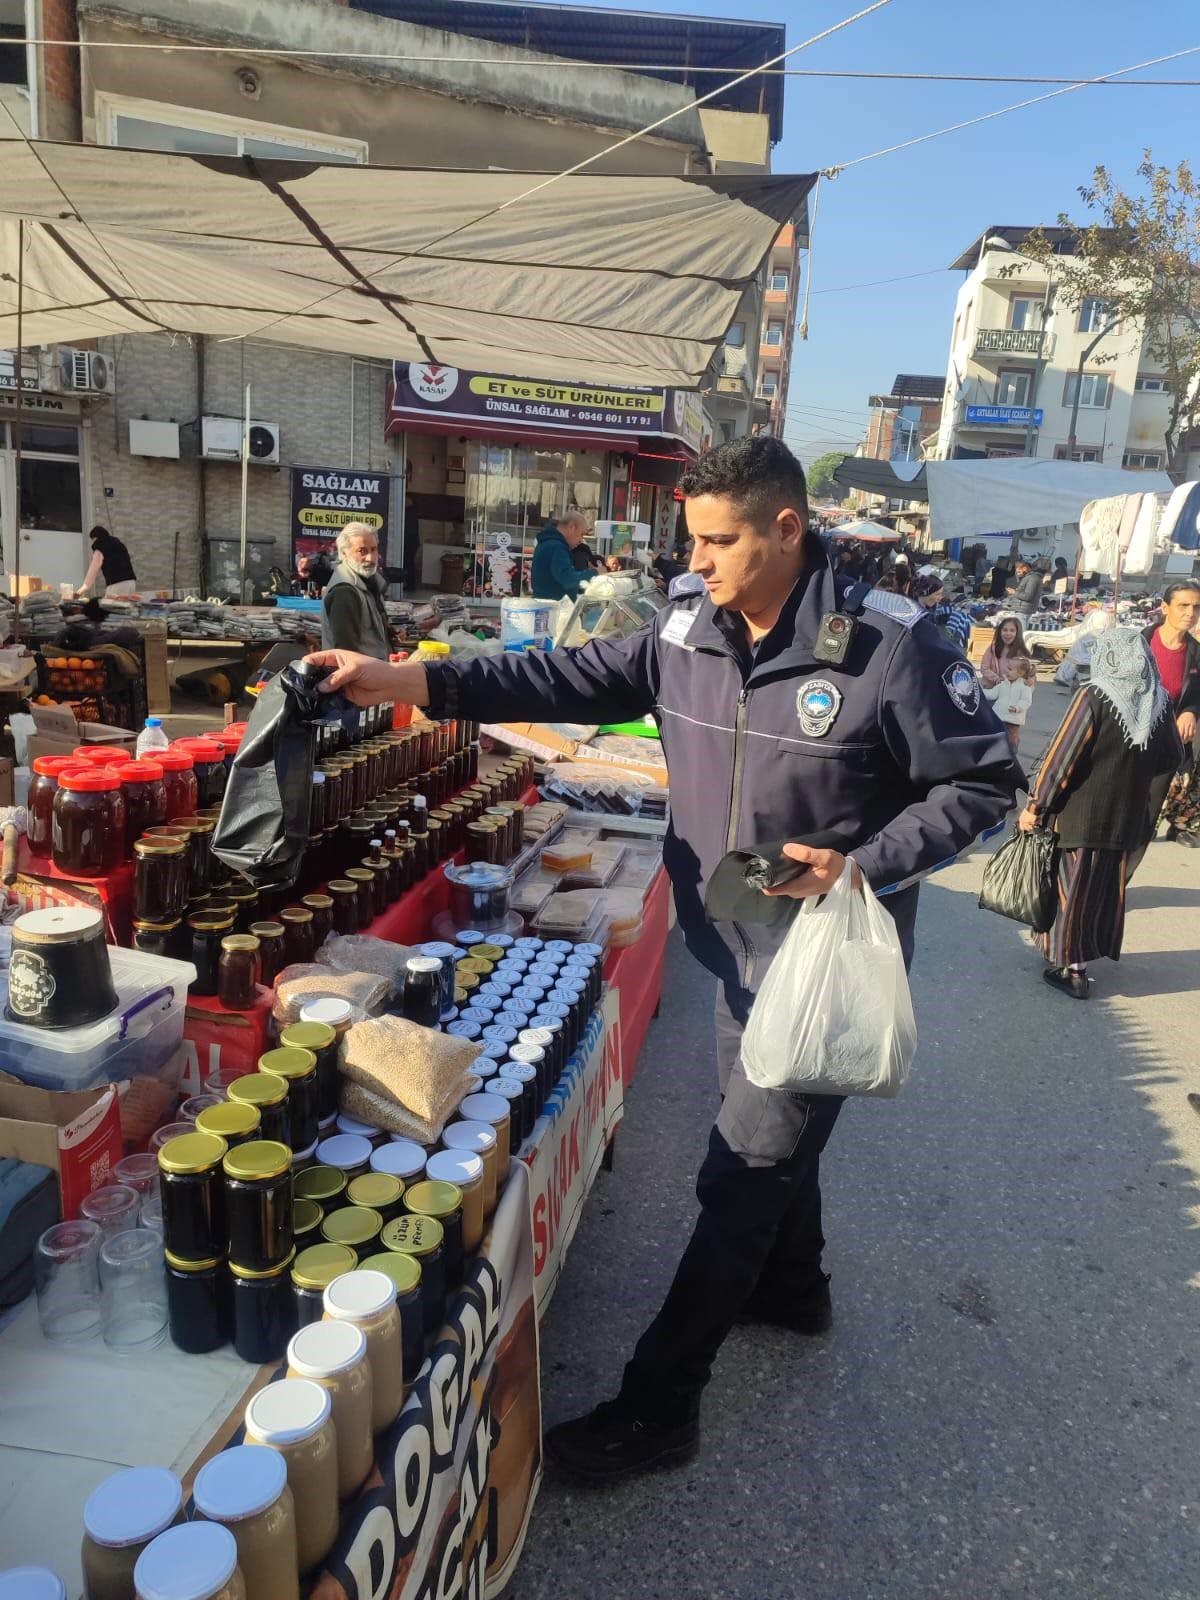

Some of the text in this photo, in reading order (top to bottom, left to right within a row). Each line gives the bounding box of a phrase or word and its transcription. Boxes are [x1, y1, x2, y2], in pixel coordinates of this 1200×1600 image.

[420, 385, 447, 395] KASAP
[488, 382, 651, 409] ET ve SÜT ÜRÜNLERİ
[486, 398, 522, 413] ÜNSAL
[525, 404, 570, 419] SAĞLAM
[578, 411, 603, 422] 0546
[605, 413, 622, 423] 601
[626, 415, 638, 425] 17
[640, 416, 651, 425] 91
[302, 472, 380, 494] SAĞLAM
[310, 491, 372, 510] KASAP
[305, 512, 314, 522] ET
[314, 515, 324, 523] ve
[325, 511, 338, 524] SÜT
[658, 490, 672, 550] TAVUK
[533, 1105, 581, 1278] SICAK
